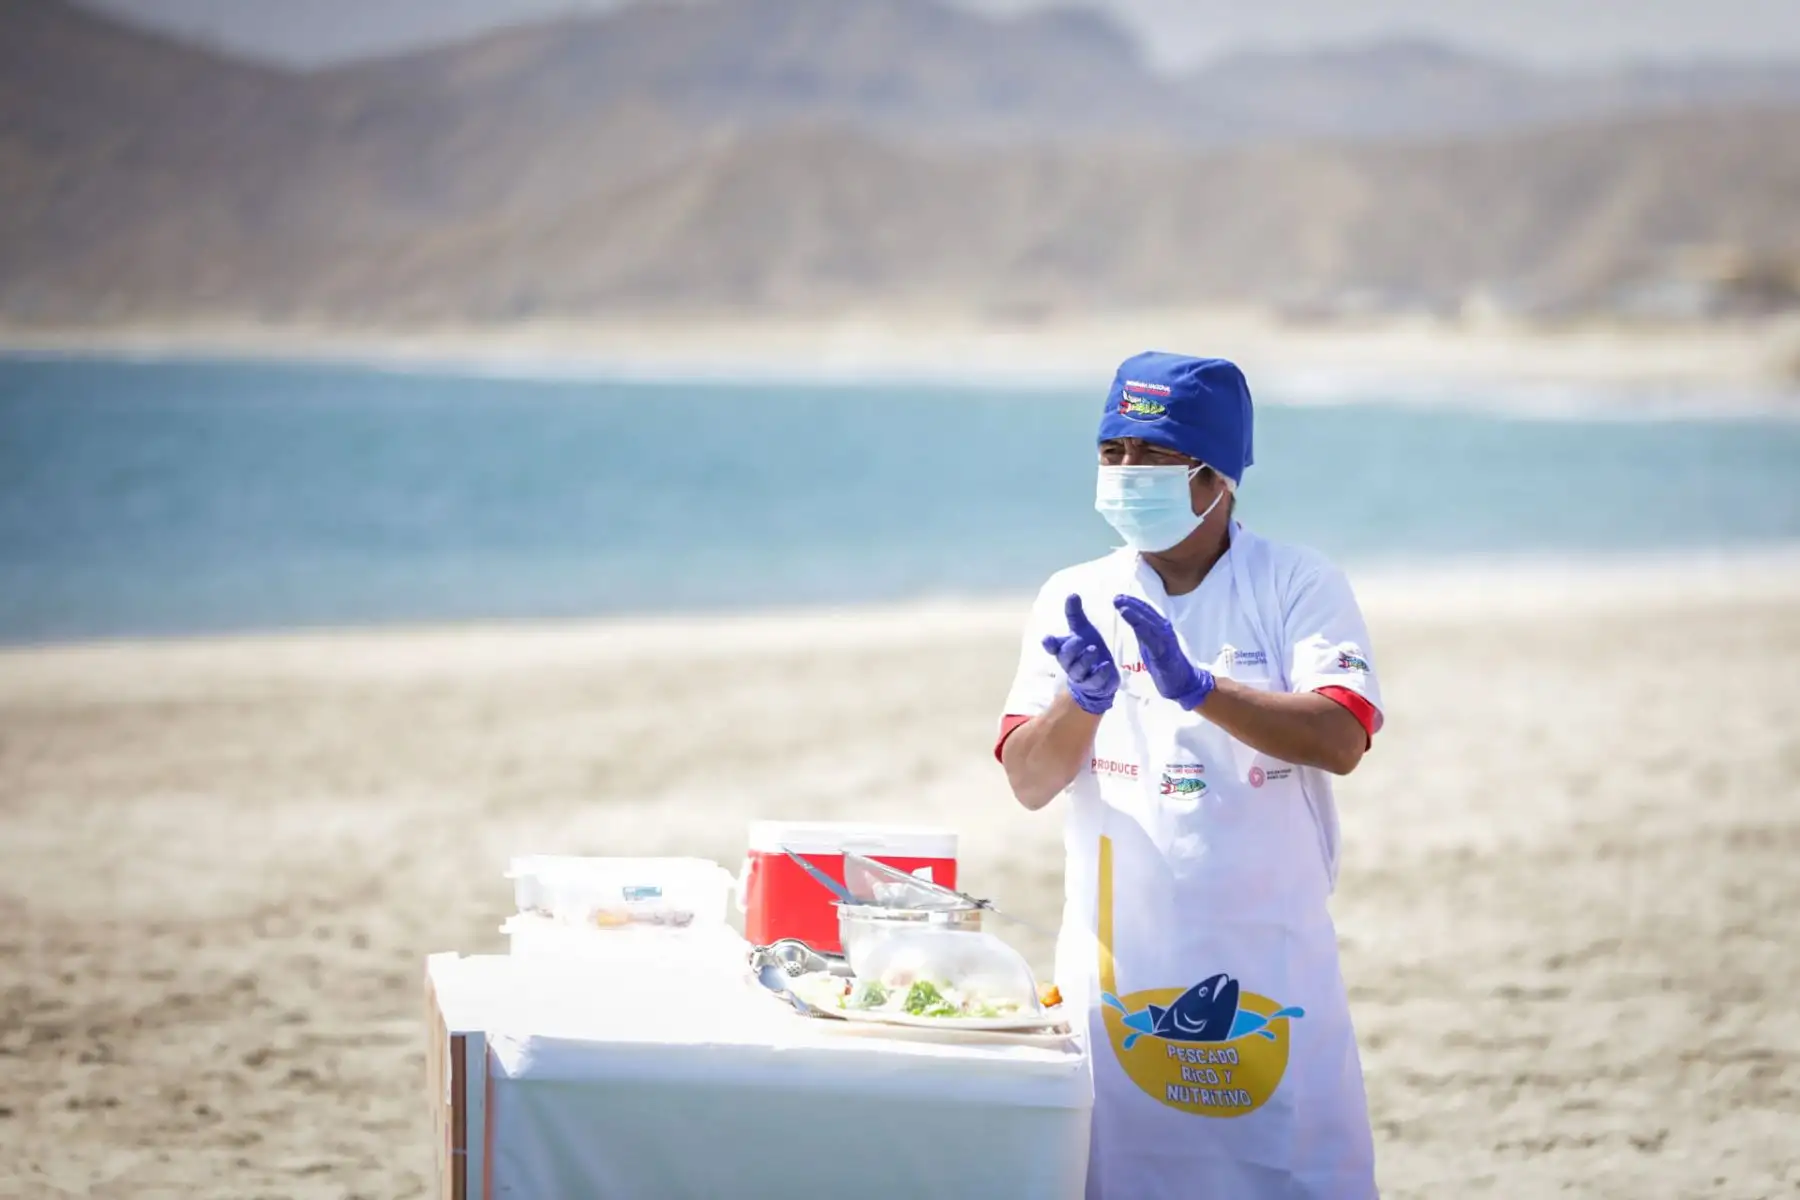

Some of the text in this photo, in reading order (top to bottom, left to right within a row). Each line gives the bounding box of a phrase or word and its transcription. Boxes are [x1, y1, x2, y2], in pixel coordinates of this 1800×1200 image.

[1091, 758, 1139, 776] PRODUCE
[1167, 1044, 1239, 1065] PESCADO
[1224, 1070, 1232, 1084] Y
